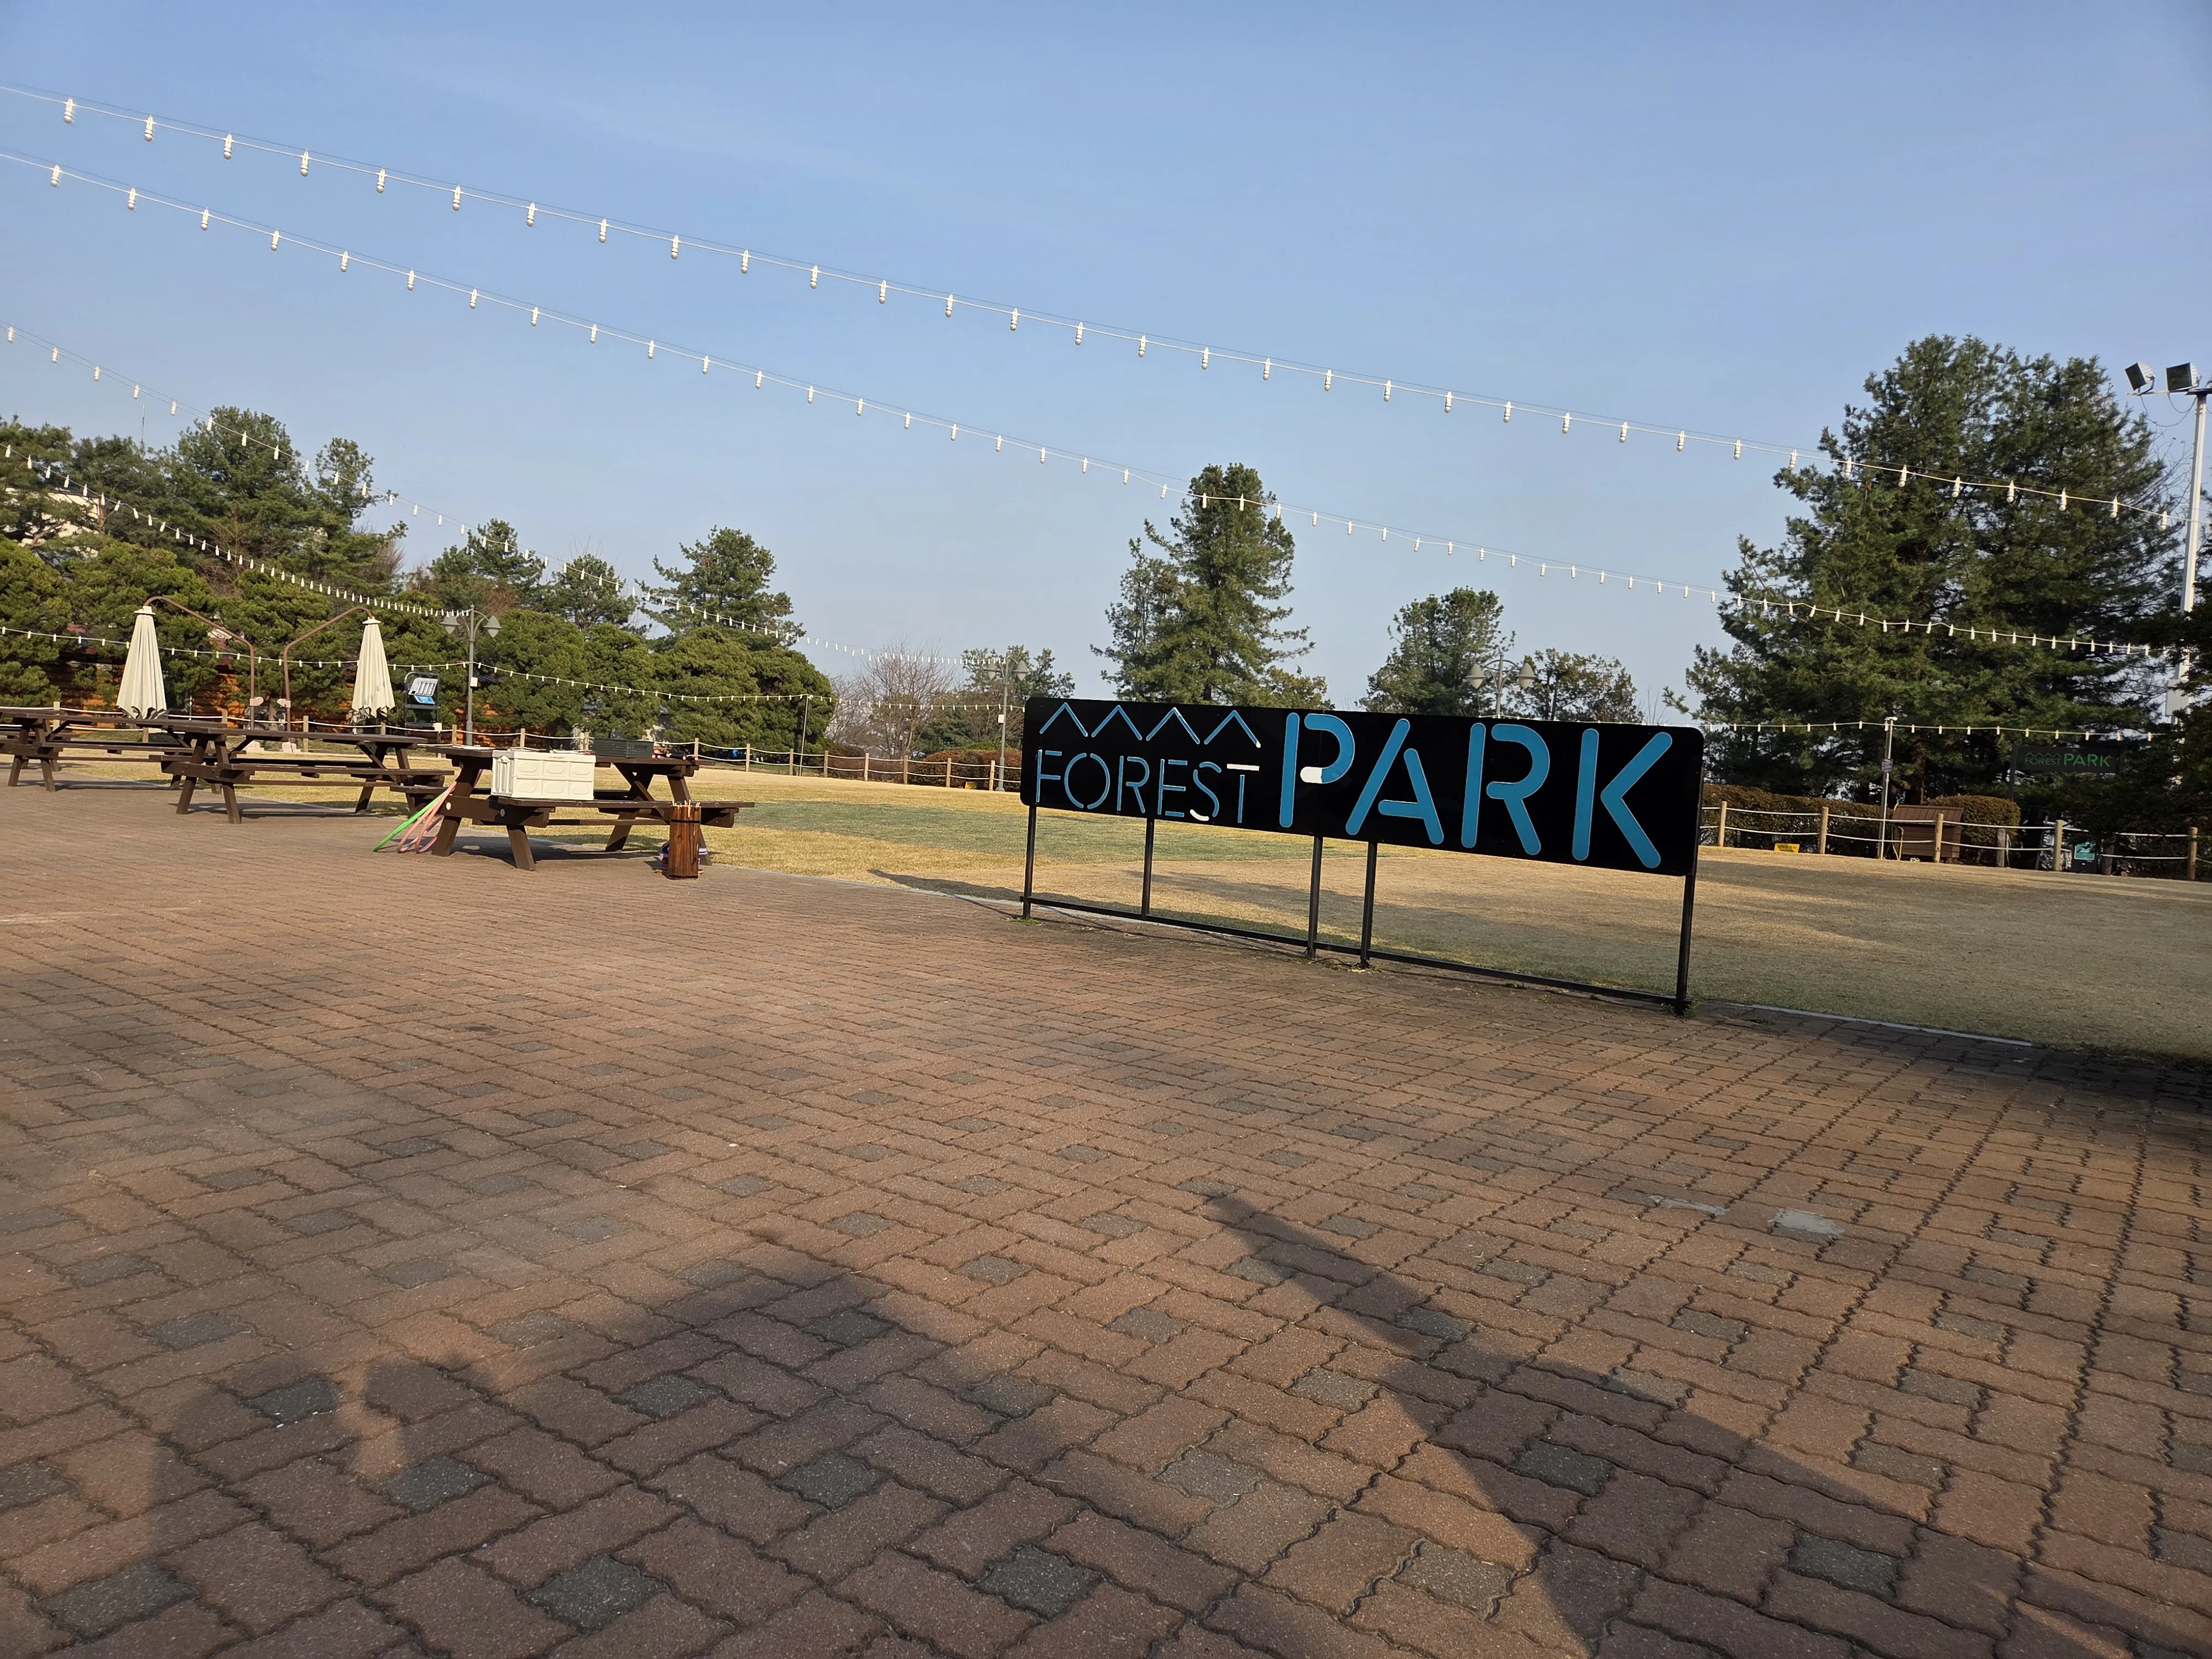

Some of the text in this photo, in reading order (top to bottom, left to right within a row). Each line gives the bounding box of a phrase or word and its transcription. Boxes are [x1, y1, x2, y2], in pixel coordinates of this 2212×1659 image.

[1036, 712, 1672, 868] FOREST PARK
[2025, 753, 2110, 767] FOREST PARK
